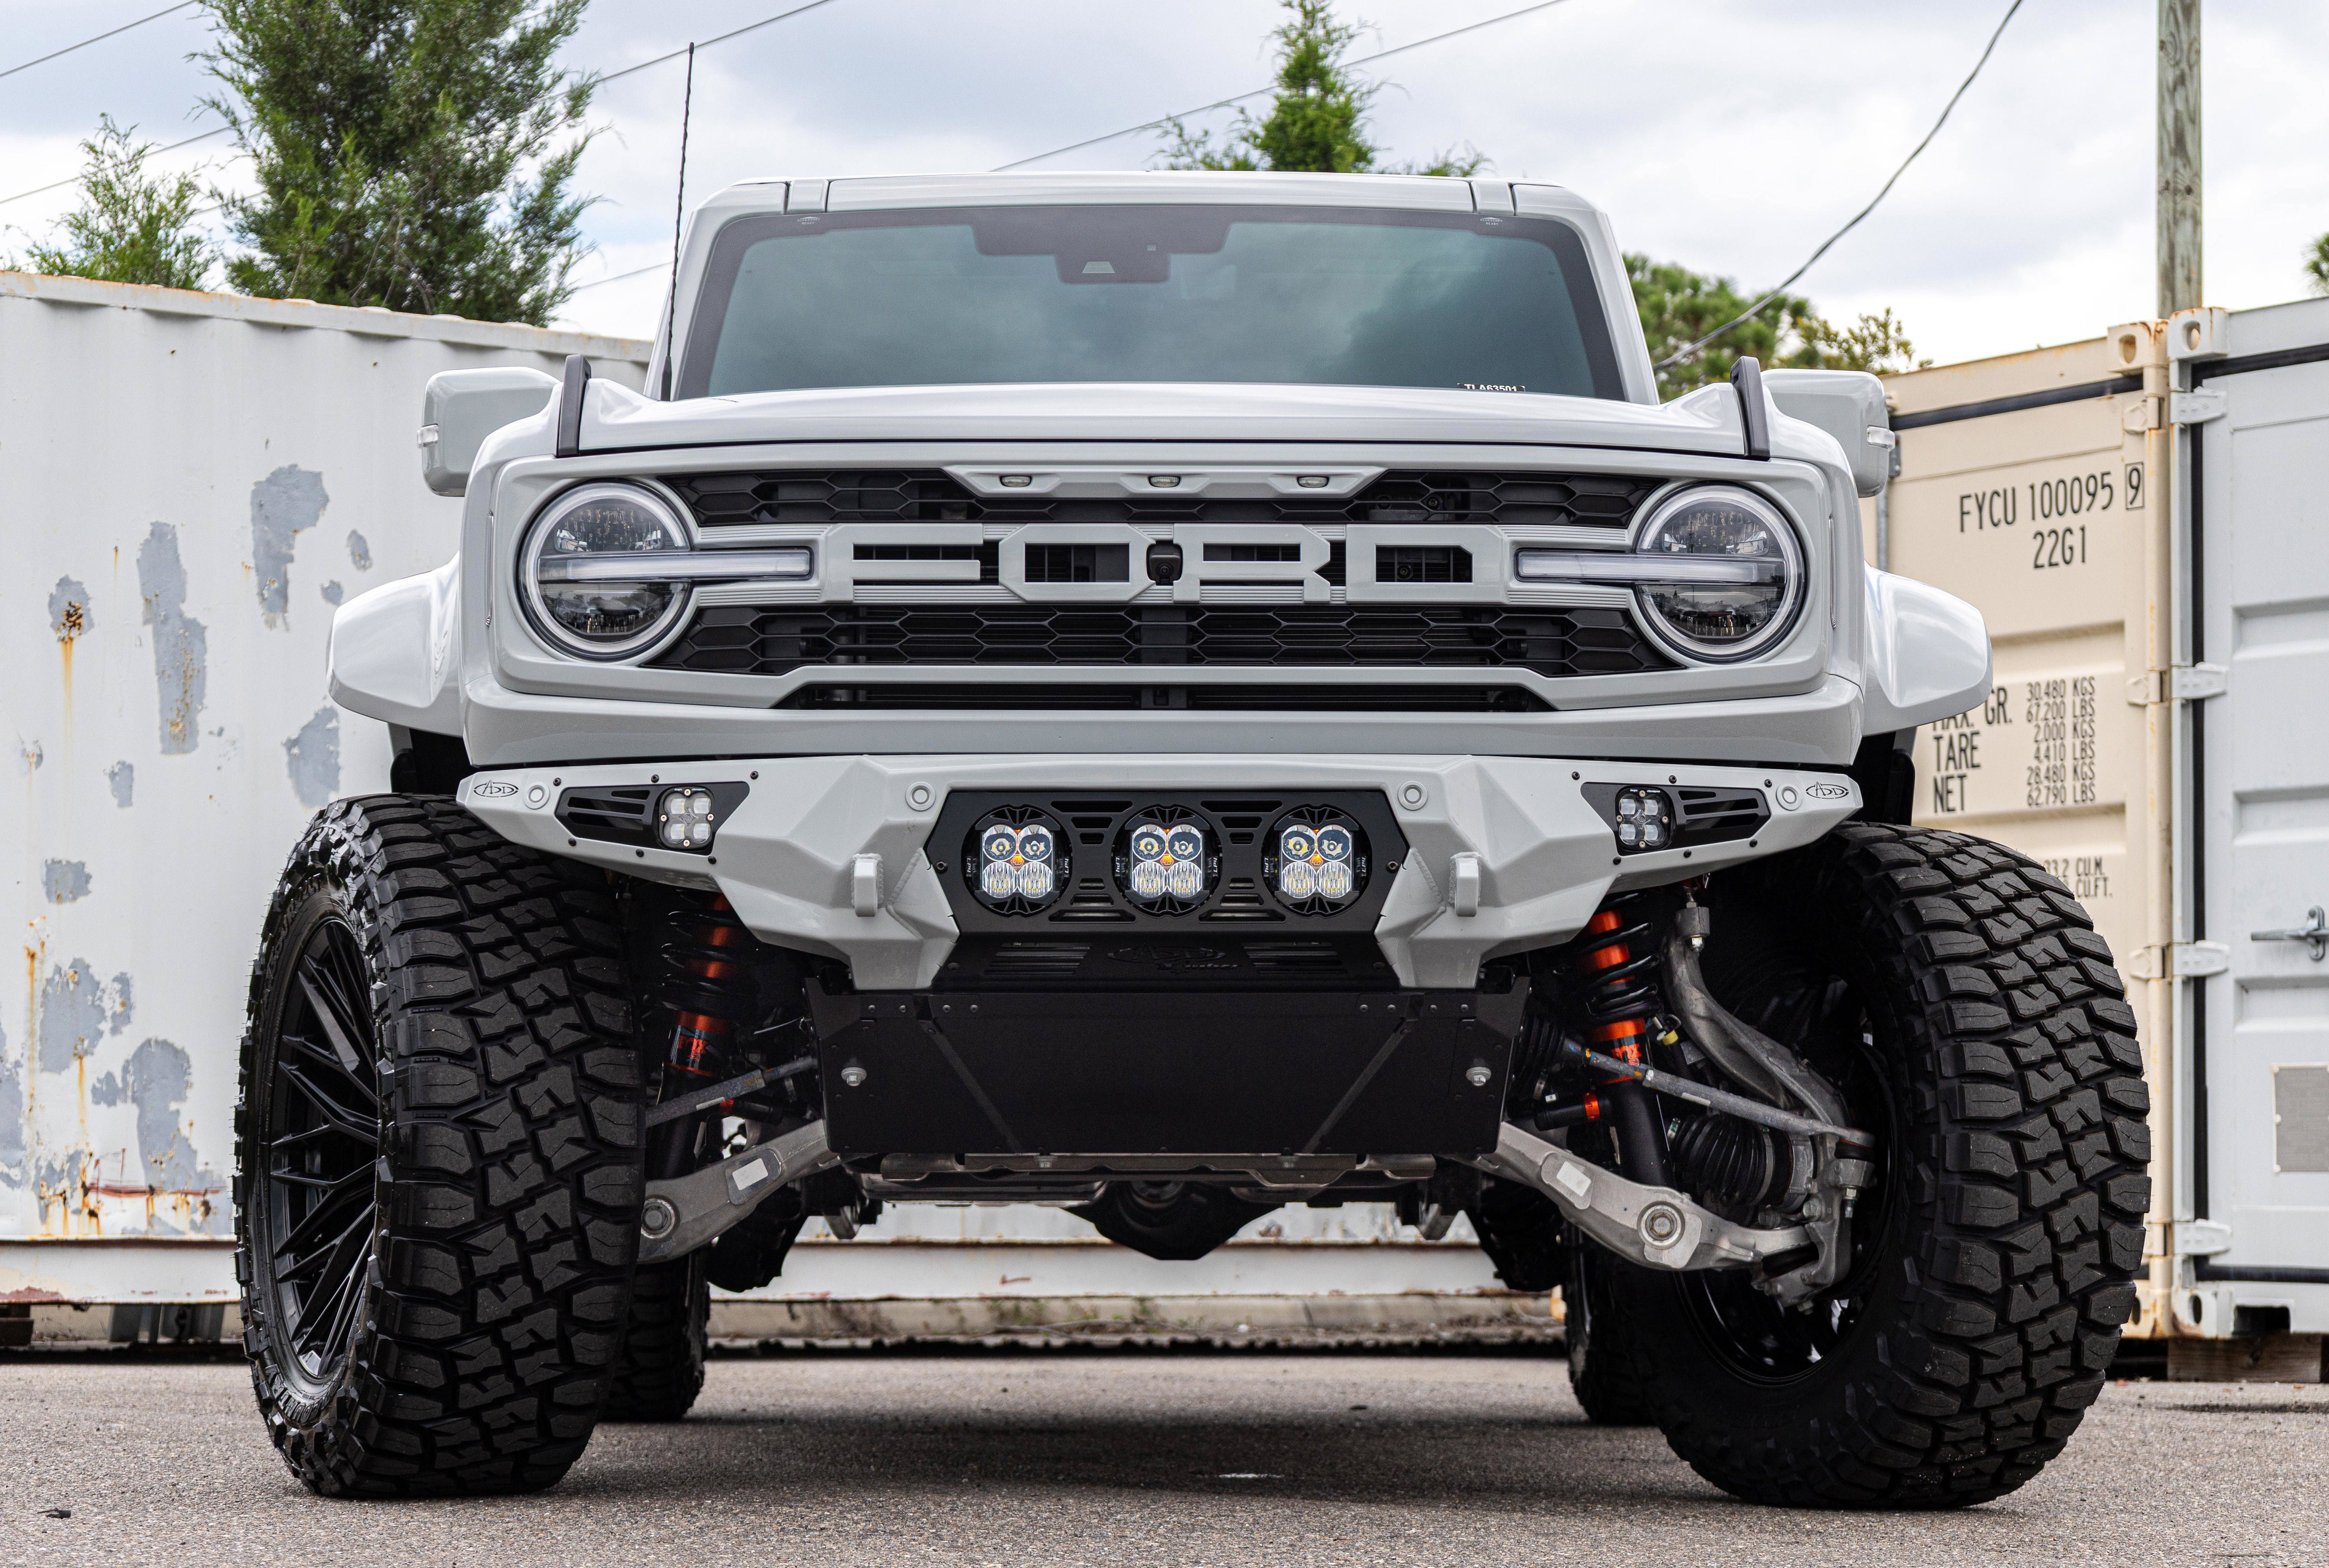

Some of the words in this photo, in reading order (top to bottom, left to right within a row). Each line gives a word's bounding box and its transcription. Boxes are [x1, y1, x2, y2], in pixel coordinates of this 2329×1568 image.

[1959, 486, 2016, 532] FYCU
[2029, 471, 2113, 521] 100095
[2128, 466, 2141, 505] 9
[2033, 525, 2086, 569] 22G1
[823, 523, 1507, 604] FORD
[2027, 679, 2066, 702] 30.480
[2072, 676, 2095, 696] KGS
[2027, 700, 2066, 723] 67.200
[2073, 697, 2095, 718] LBS
[2034, 721, 2066, 743] 2.000
[2073, 718, 2095, 739] KGS
[1934, 730, 1981, 772] TARE
[2034, 742, 2066, 763] 4.410
[2073, 739, 2095, 760] LBS
[2027, 763, 2066, 786] 28.480
[2073, 760, 2095, 781] KGS
[1934, 774, 1967, 813] NET
[2027, 784, 2067, 806] 62.790
[2073, 781, 2095, 802] LBS
